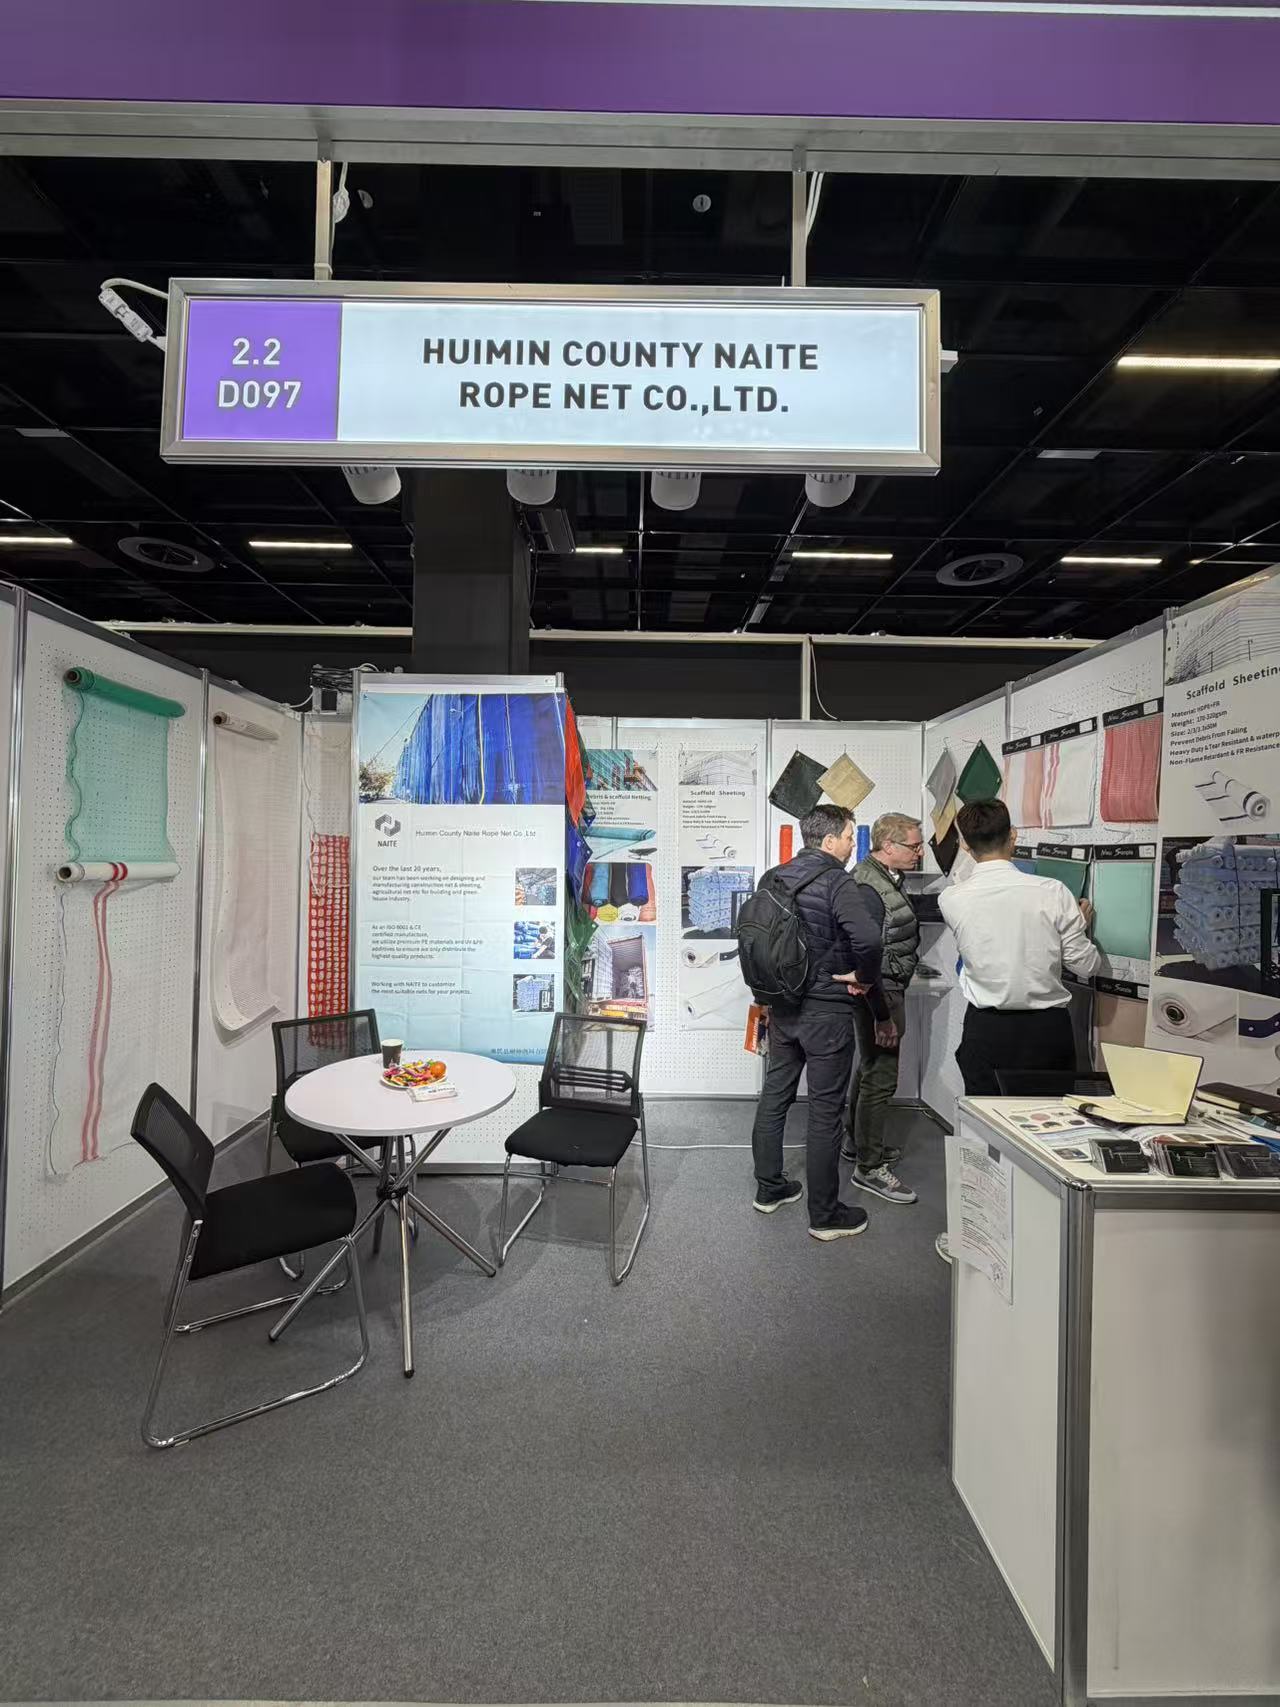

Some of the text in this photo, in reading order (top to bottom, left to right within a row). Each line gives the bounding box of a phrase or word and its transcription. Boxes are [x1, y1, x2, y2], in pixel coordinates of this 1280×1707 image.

[232, 337, 281, 365] 2.2
[423, 338, 818, 370] HUIMIN COUNTY NAITE
[218, 380, 301, 408] D097
[459, 381, 551, 409] ROPE
[564, 383, 632, 410] NET
[1186, 666, 1280, 700] Scaffold Sheetin
[1170, 738, 1195, 747] Prevent
[1227, 727, 1248, 736] Falling
[1256, 731, 1280, 740] waterp
[377, 840, 397, 848] NAITE
